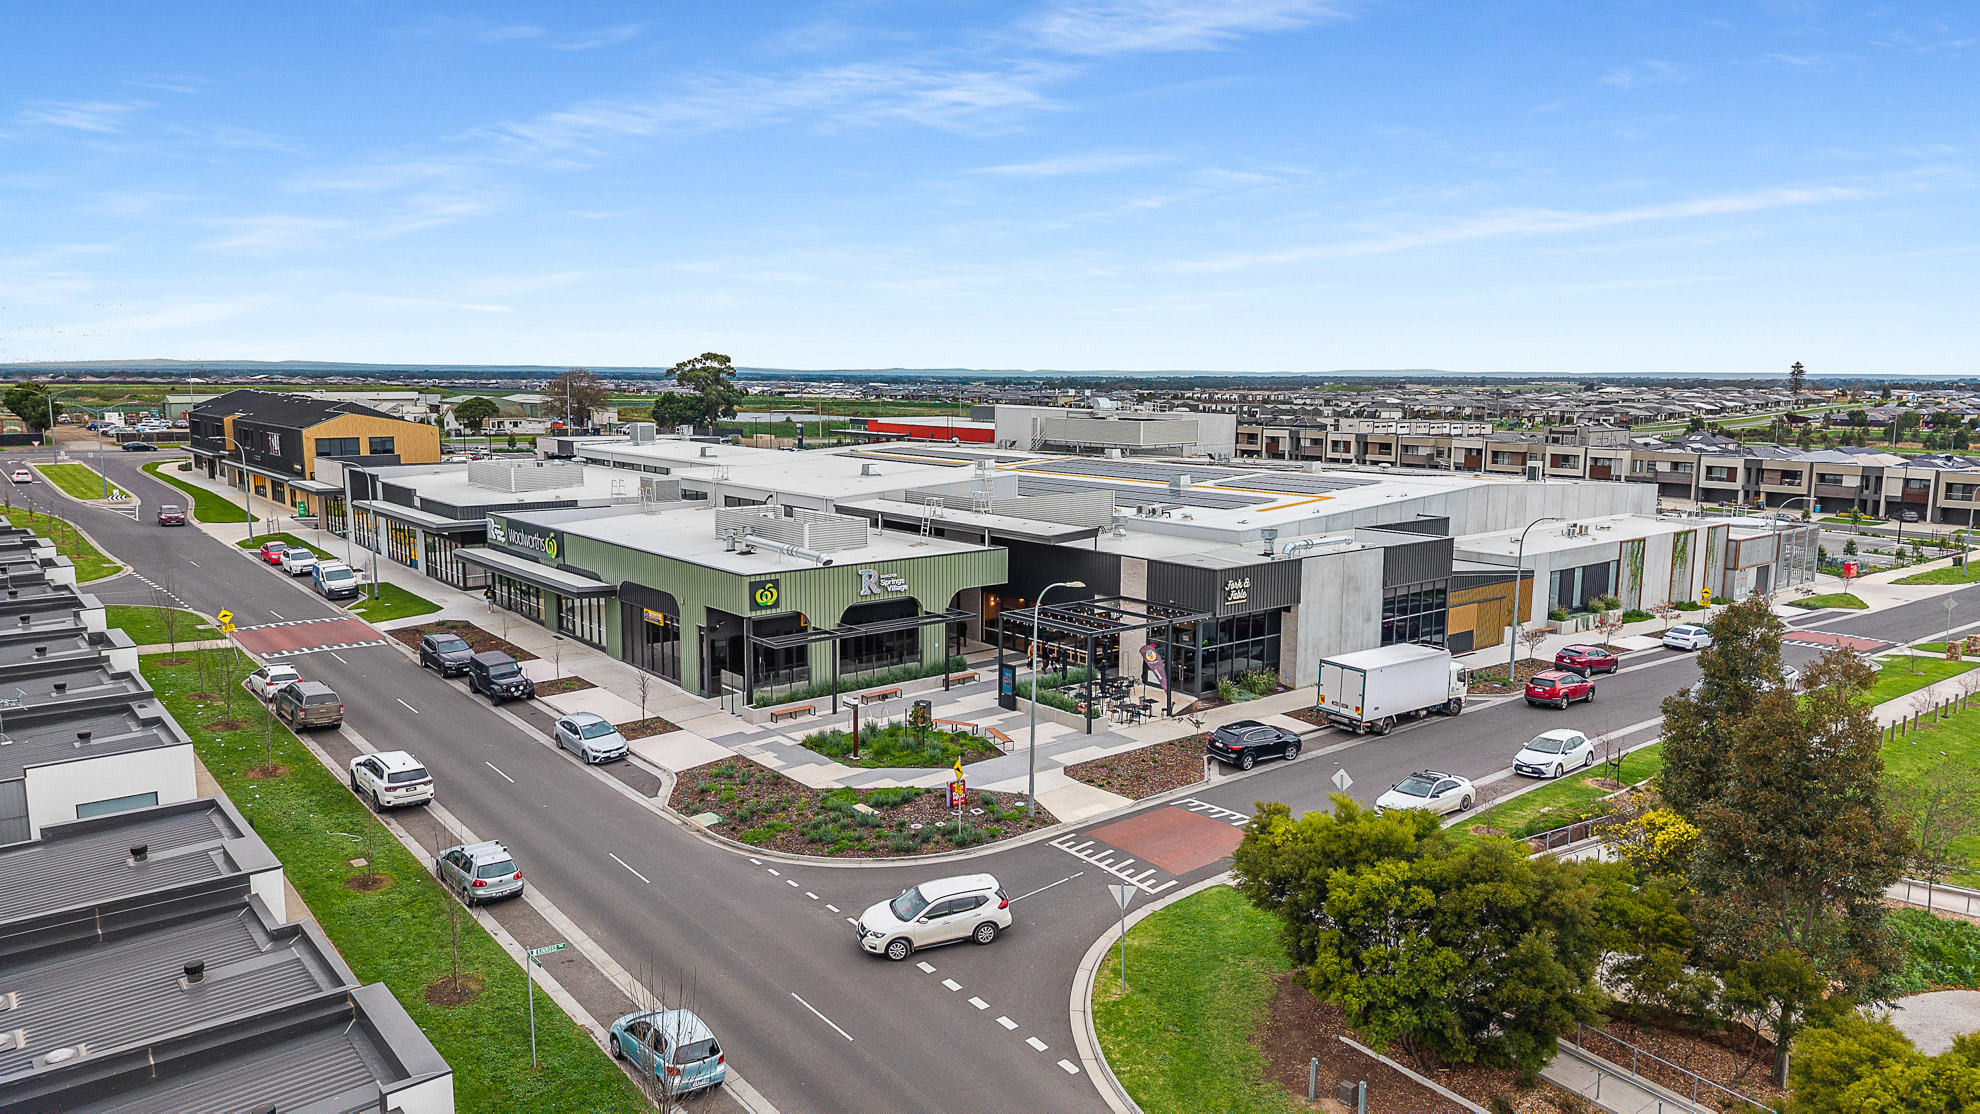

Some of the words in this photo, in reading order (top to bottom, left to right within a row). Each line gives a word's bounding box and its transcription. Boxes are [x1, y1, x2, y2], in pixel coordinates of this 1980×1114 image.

[859, 569, 881, 595] R
[880, 578, 905, 587] Springs
[1225, 579, 1243, 590] Fork
[1244, 578, 1250, 588] &
[1228, 589, 1247, 600] Fable
